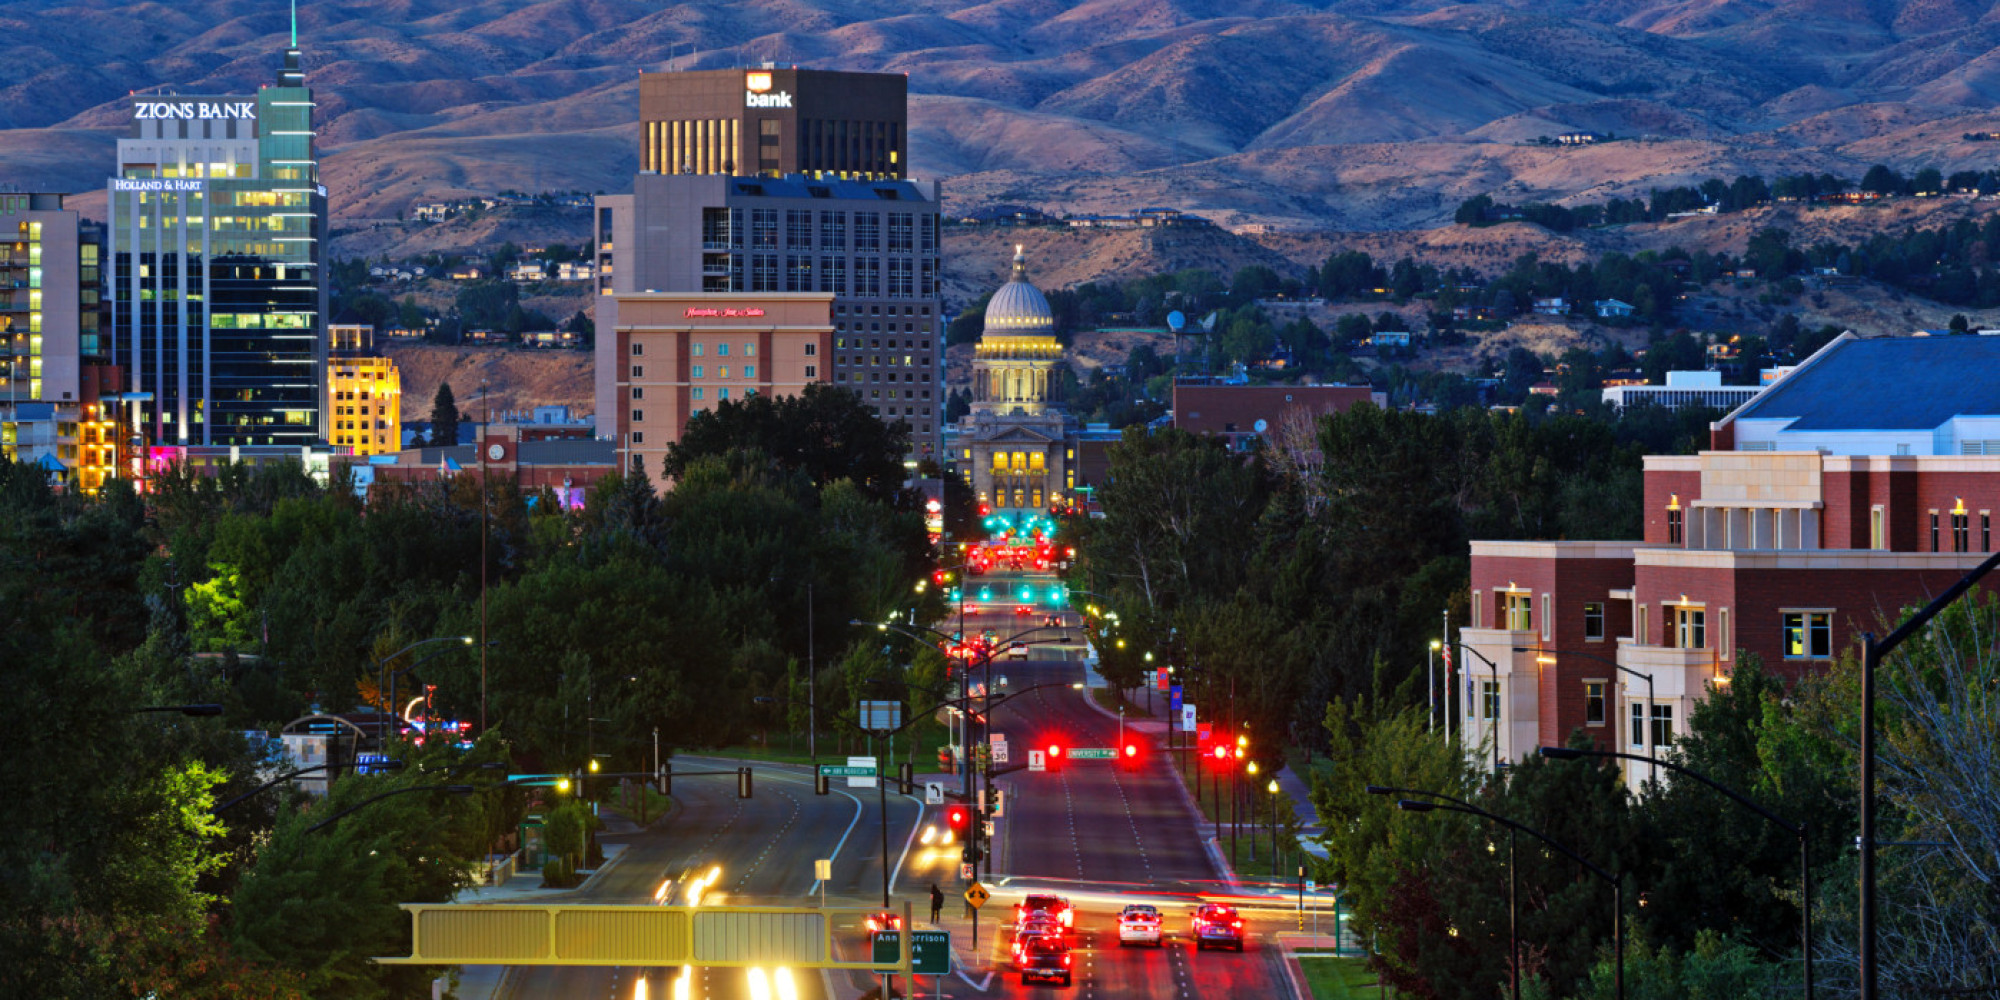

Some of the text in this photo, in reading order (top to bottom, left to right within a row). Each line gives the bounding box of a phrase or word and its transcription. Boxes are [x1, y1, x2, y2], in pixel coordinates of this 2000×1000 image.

[746, 90, 792, 107] bank
[135, 102, 256, 119] ZIONS BANK
[164, 180, 173, 190] &
[994, 752, 1006, 761] 30
[1068, 749, 1101, 758] UNIVERSITY
[877, 933, 945, 942] Ann orrison
